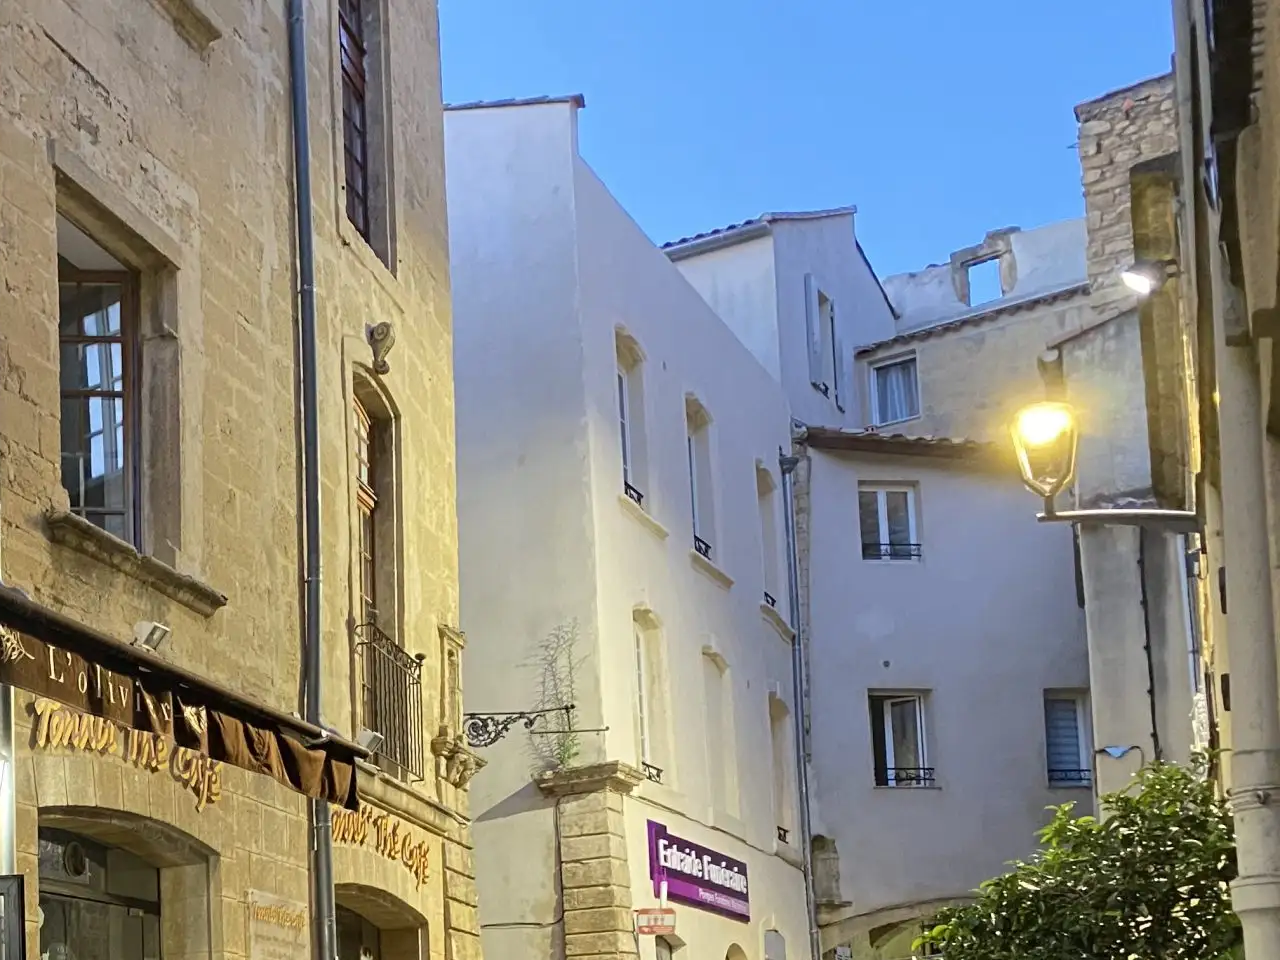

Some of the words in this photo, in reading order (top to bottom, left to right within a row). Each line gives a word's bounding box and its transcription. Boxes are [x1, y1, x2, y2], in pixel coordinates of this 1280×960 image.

[47, 644, 172, 721] L'olivir
[658, 838, 703, 878] Entraide
[702, 854, 748, 894] Funéraire
